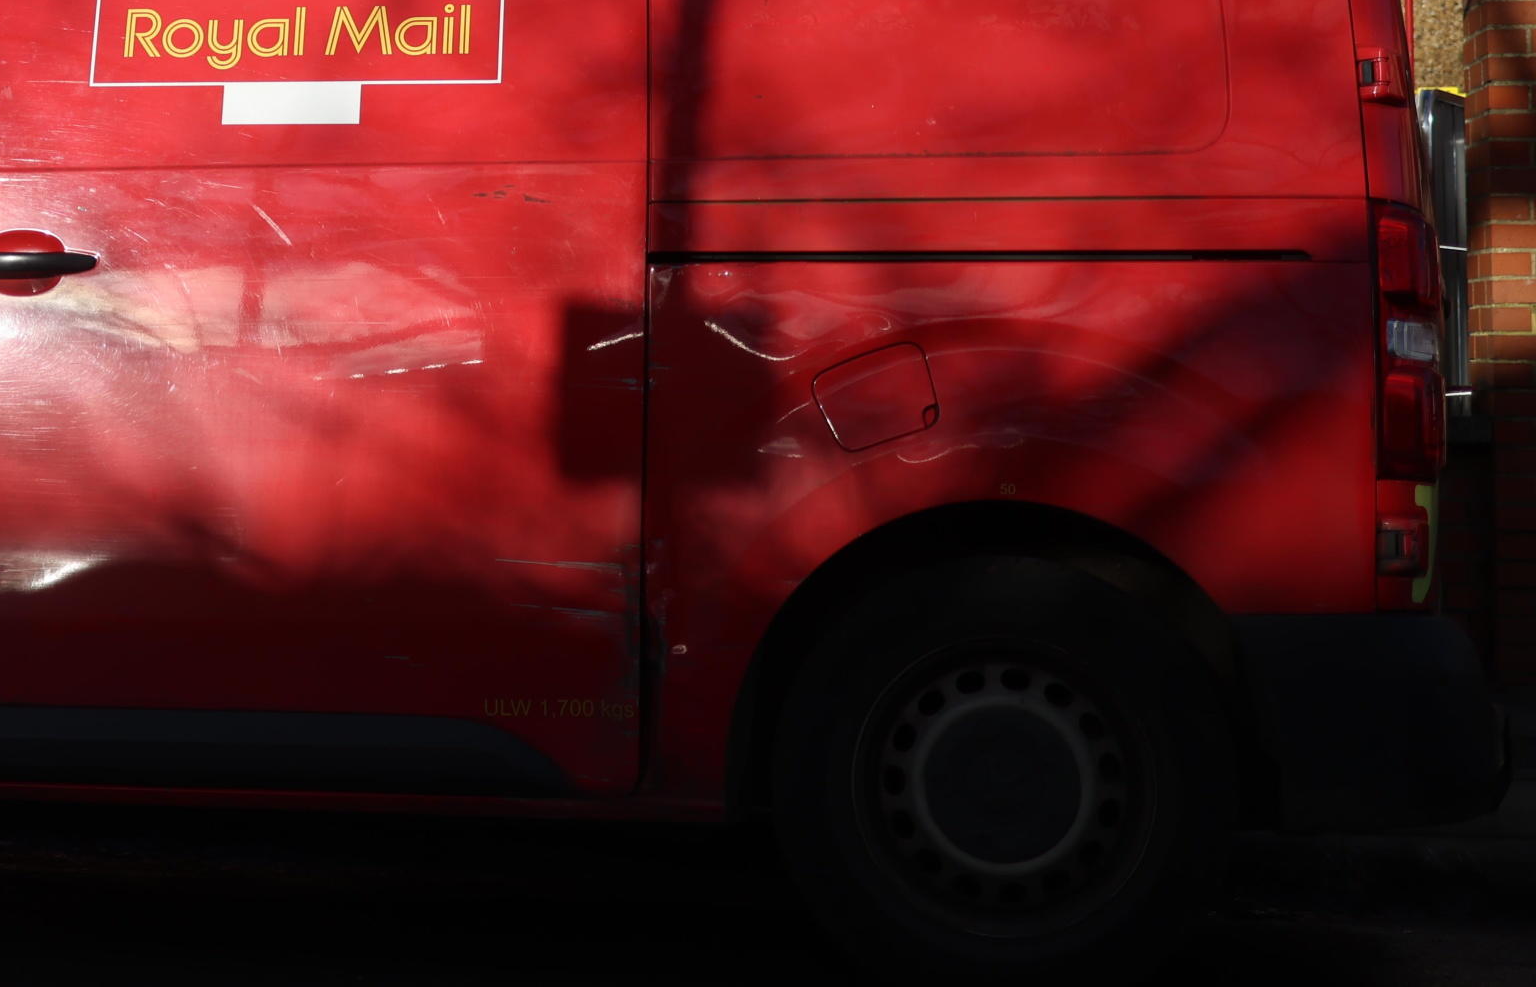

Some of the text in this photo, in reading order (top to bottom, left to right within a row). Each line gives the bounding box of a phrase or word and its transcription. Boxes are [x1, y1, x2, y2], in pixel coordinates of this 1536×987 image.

[124, 4, 472, 70] Royal Mail
[999, 483, 1016, 495] 50
[483, 698, 636, 723] ULW 1,700 kgs
